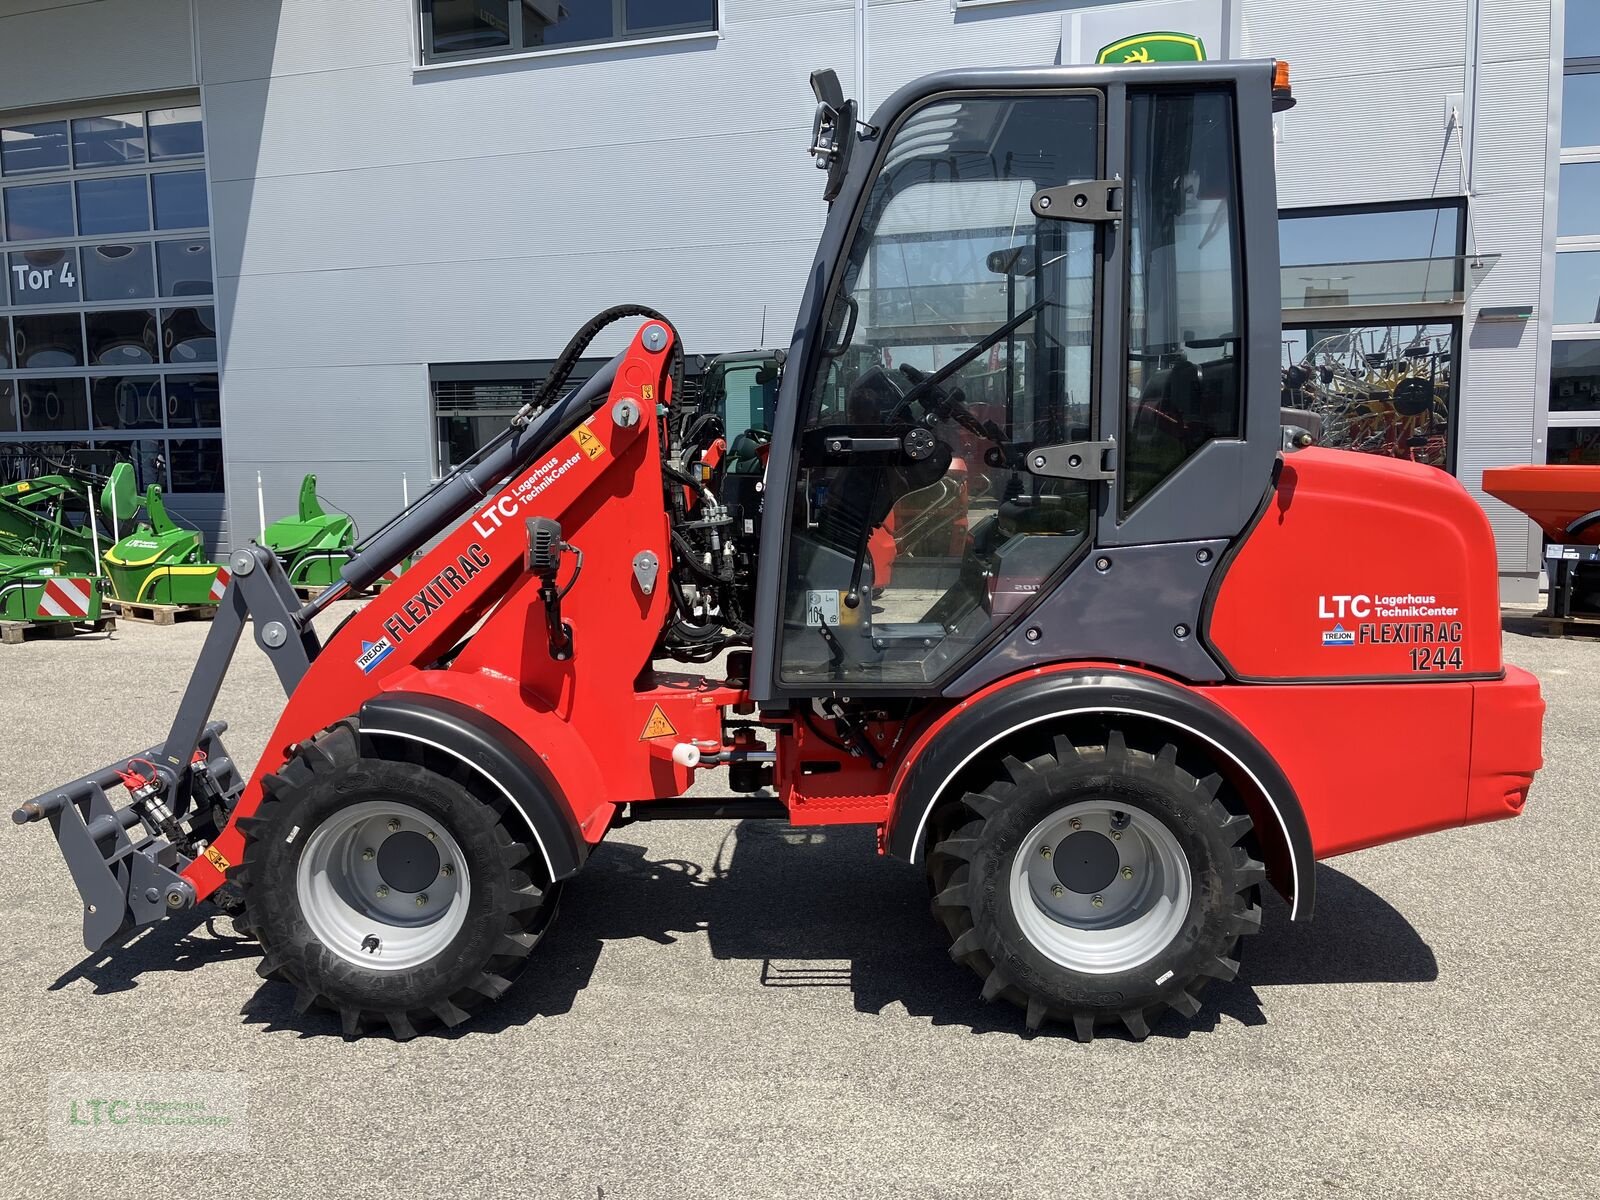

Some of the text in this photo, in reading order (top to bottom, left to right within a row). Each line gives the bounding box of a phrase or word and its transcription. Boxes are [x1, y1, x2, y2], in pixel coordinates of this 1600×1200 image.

[12, 262, 75, 290] Tor 4
[511, 457, 559, 497] Lagerhaus
[519, 452, 581, 505] TechnikCenter
[472, 496, 519, 539] LTC
[383, 543, 492, 643] FLEXITRAC
[1375, 594, 1436, 606] Lagerhaus
[1318, 594, 1371, 619] LTC
[1375, 606, 1459, 617] TechnikCenter
[1325, 622, 1463, 644] TREJON FLEXITRAC
[358, 640, 387, 666] TREJON
[1409, 647, 1463, 671] 1244
